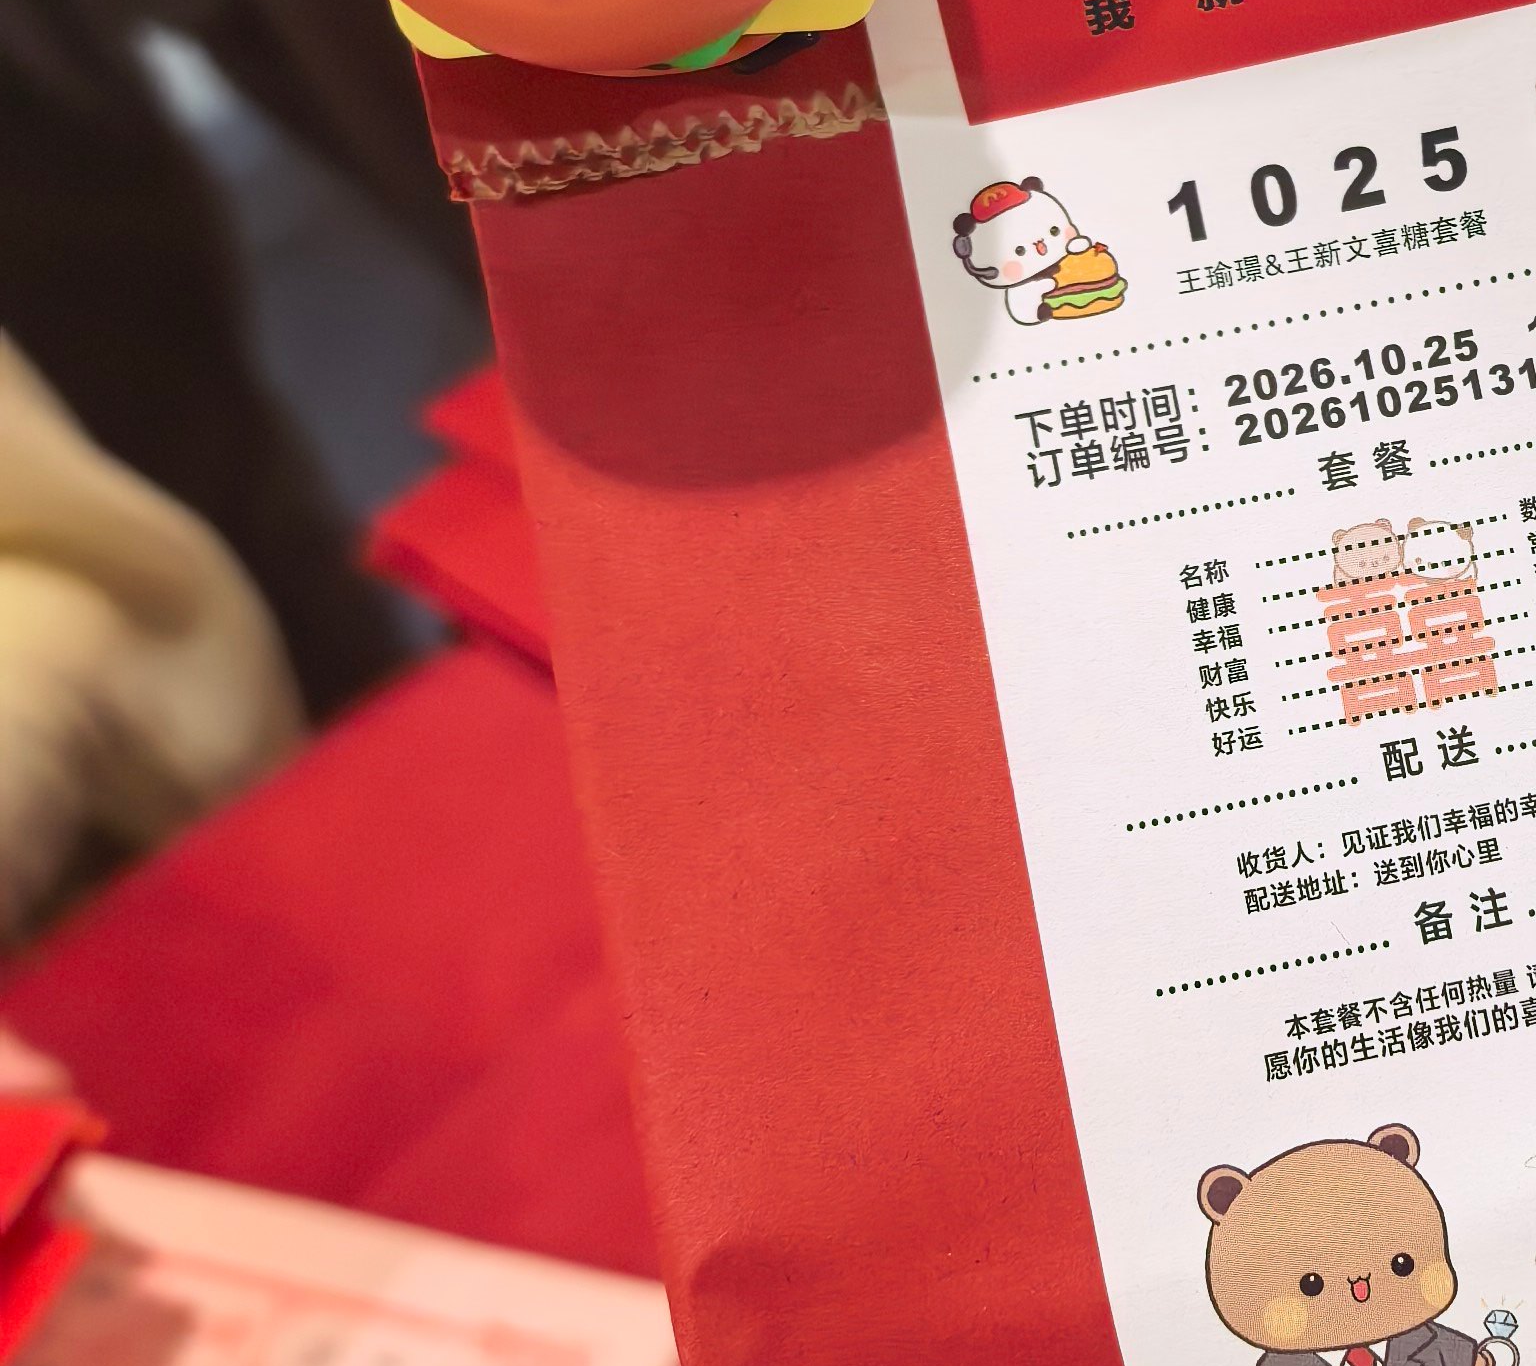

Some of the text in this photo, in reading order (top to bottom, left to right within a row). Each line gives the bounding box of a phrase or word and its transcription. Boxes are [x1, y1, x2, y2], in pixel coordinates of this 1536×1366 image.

[1224, 328, 1479, 408] 2026.10.25
[1179, 558, 1230, 590] 名称
[1186, 592, 1237, 624] 健康
[1191, 623, 1243, 655] 幸福
[1198, 657, 1249, 690] 财富
[1205, 690, 1257, 724] 快乐
[1211, 725, 1264, 758] 好运
